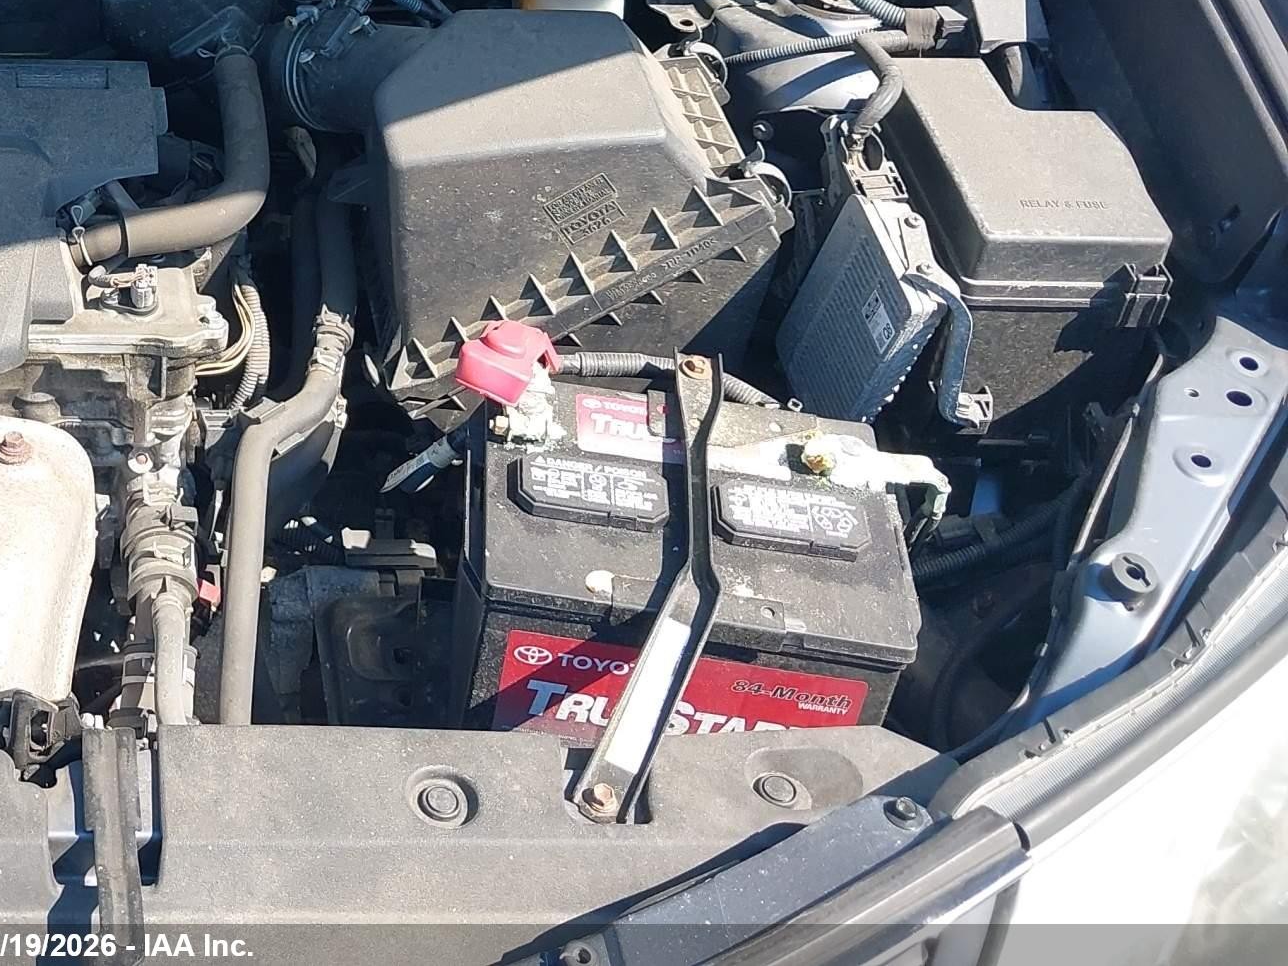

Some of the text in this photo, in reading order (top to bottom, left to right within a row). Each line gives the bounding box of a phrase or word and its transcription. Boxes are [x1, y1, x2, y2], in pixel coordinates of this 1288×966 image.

[1019, 199, 1113, 210] RELAY & FUSE
[563, 202, 618, 235] TOYOTA
[602, 401, 648, 416] TOYOT
[546, 457, 594, 472] DANGER
[603, 465, 648, 479] POISON
[557, 652, 636, 676] TOYO
[730, 679, 853, 710] 84-Month
[797, 701, 850, 716] WARRANTY
